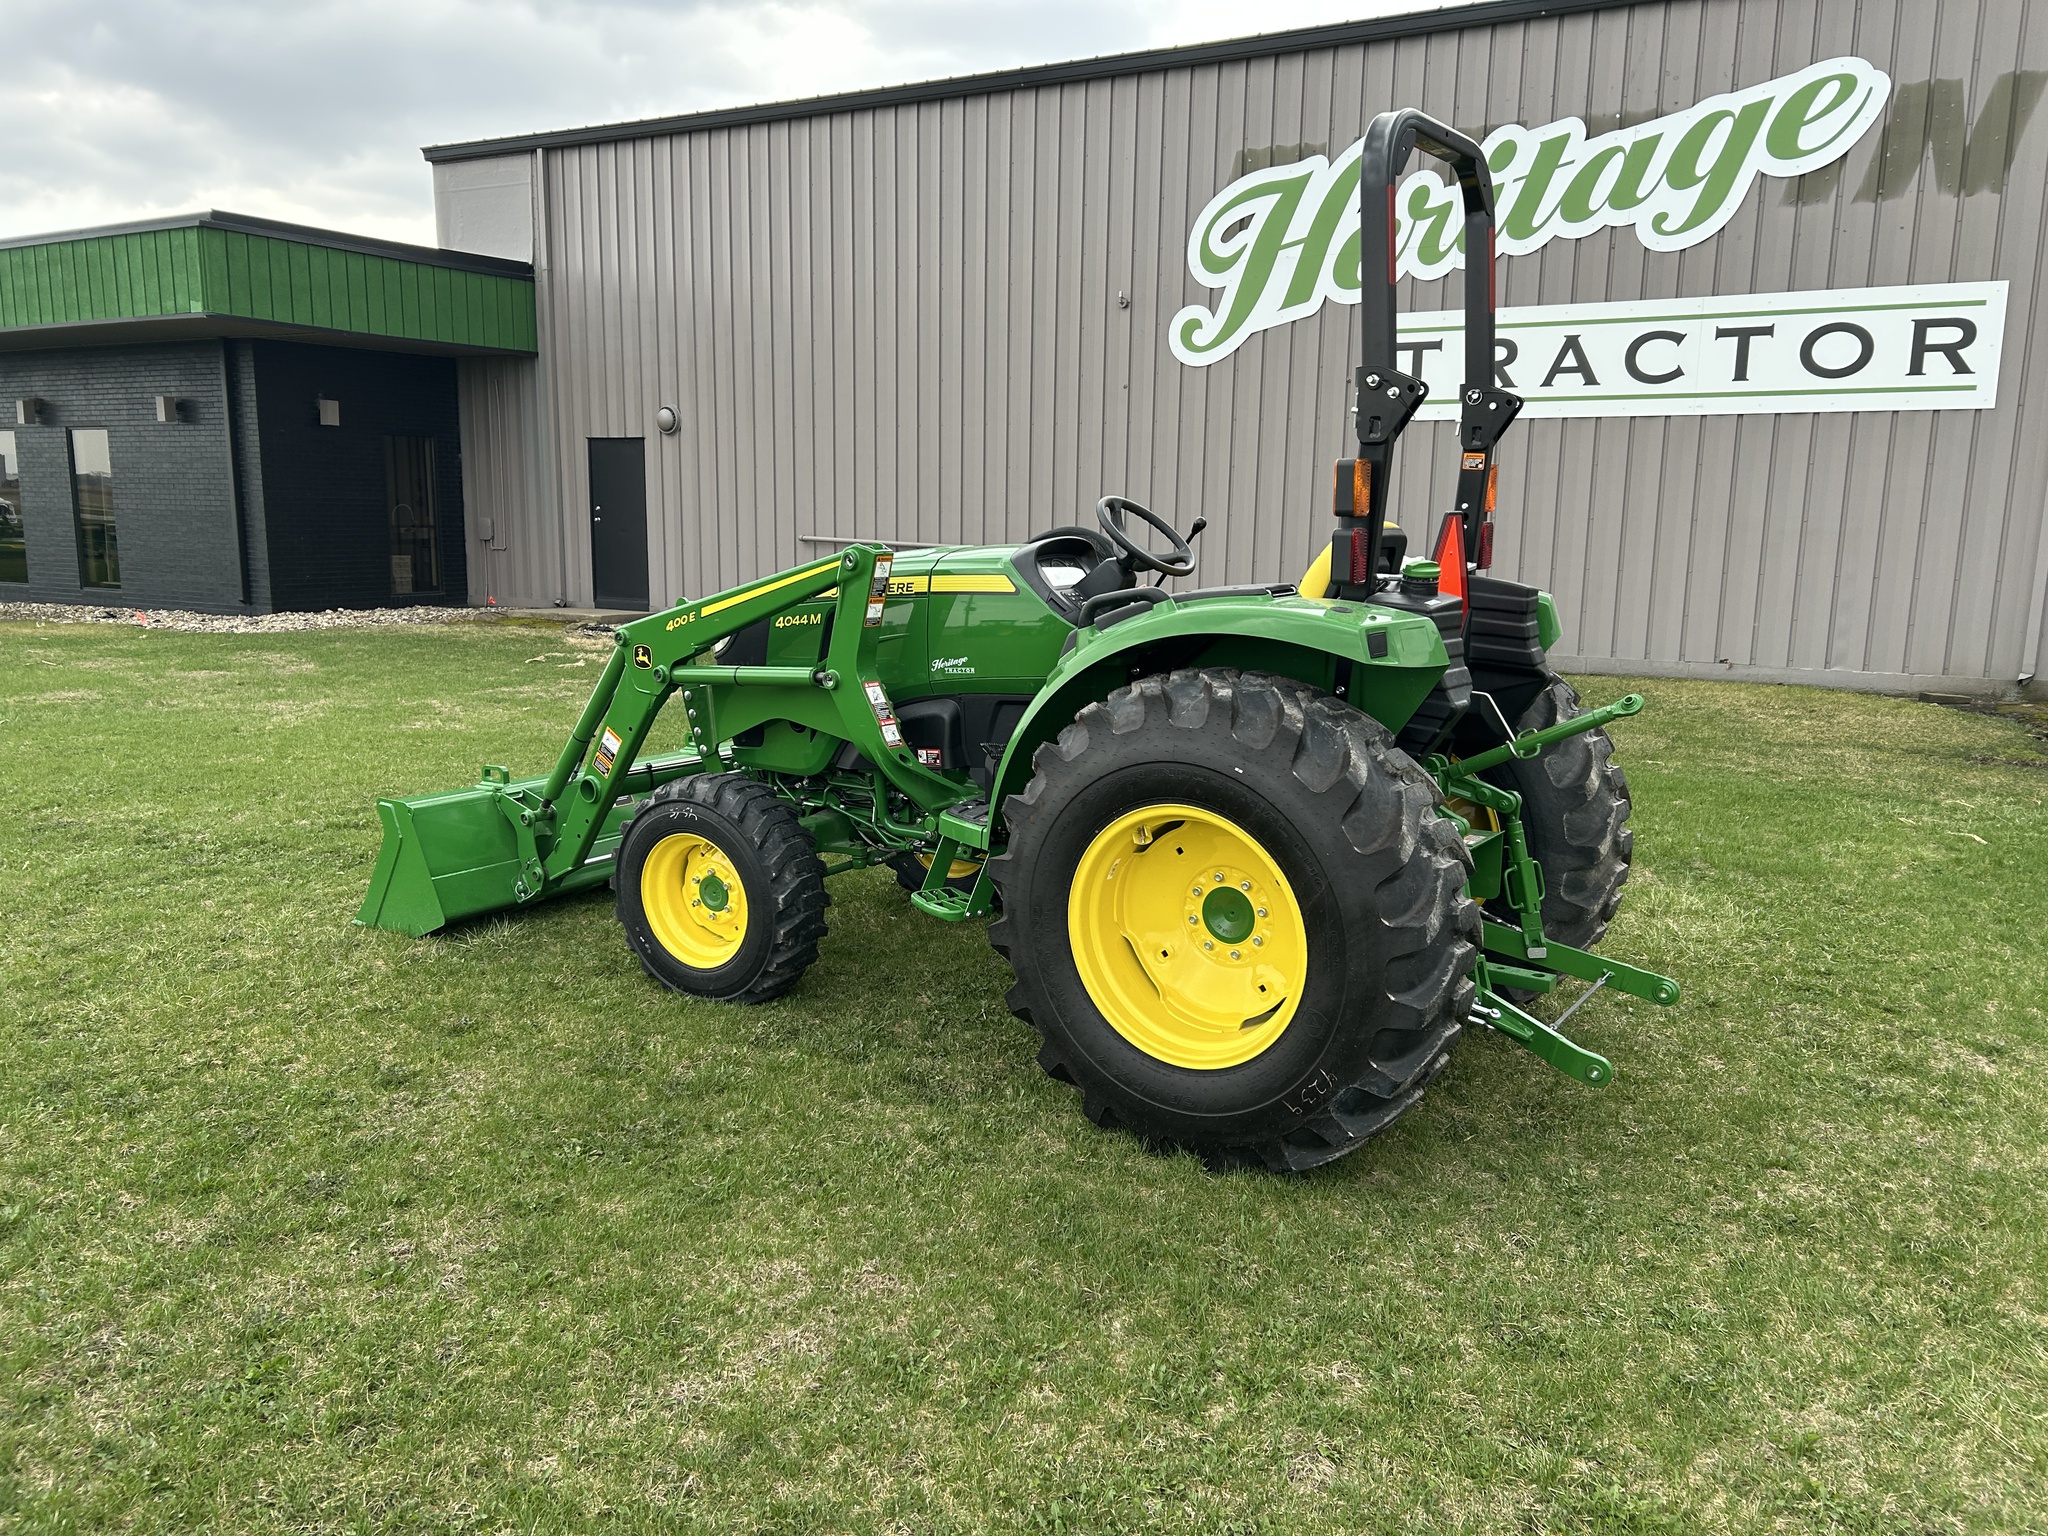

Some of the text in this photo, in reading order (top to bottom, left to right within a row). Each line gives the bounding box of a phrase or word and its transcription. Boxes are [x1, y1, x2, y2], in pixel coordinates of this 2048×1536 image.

[1180, 72, 1874, 354] Heritage
[888, 582, 915, 593] ERE
[931, 656, 968, 671] Heritage
